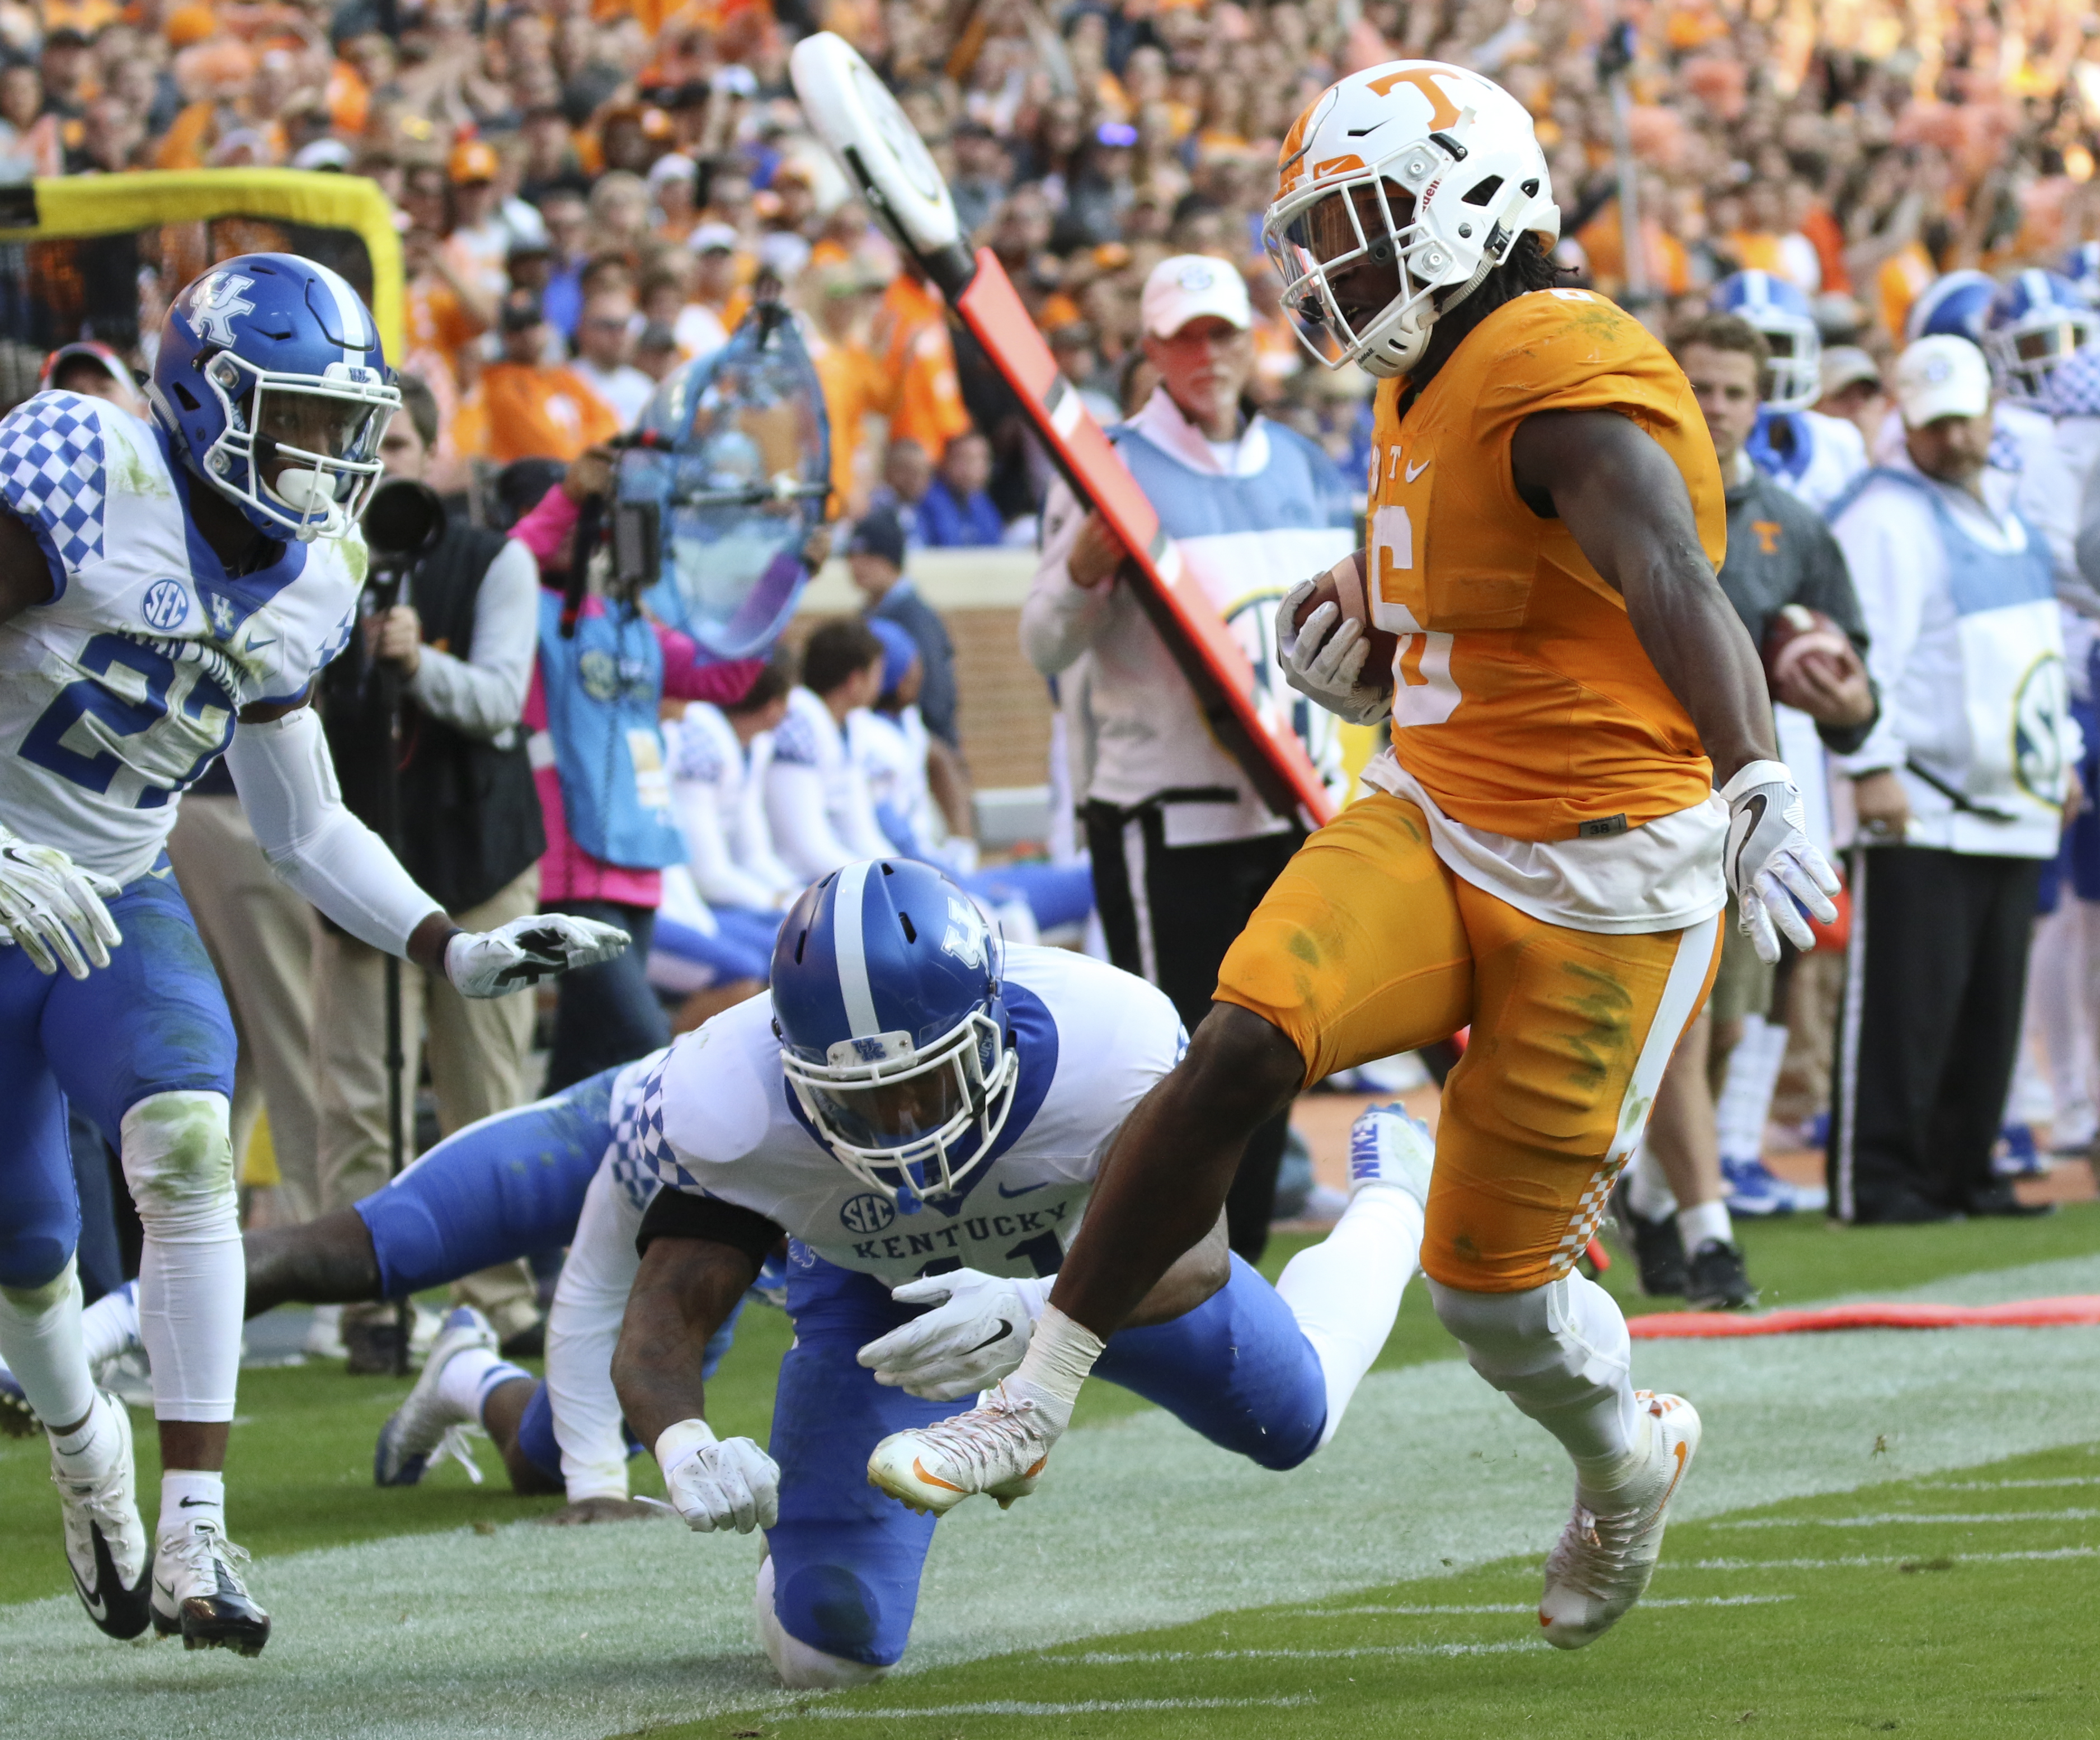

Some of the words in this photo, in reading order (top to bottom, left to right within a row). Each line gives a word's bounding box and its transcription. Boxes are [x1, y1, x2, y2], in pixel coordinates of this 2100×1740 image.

[1365, 67, 1476, 133] T
[188, 271, 256, 348] UK
[1388, 444, 1403, 479] T
[1749, 520, 1782, 555] T
[144, 580, 187, 629] SEC
[211, 592, 234, 630] UK
[1371, 504, 1462, 727] 6
[1589, 823, 1611, 834] 38
[851, 1037, 886, 1062] UK
[1352, 1123, 1382, 1180] NIKE
[843, 1194, 893, 1233] SEC
[852, 1201, 1067, 1259] KENTUCKY
